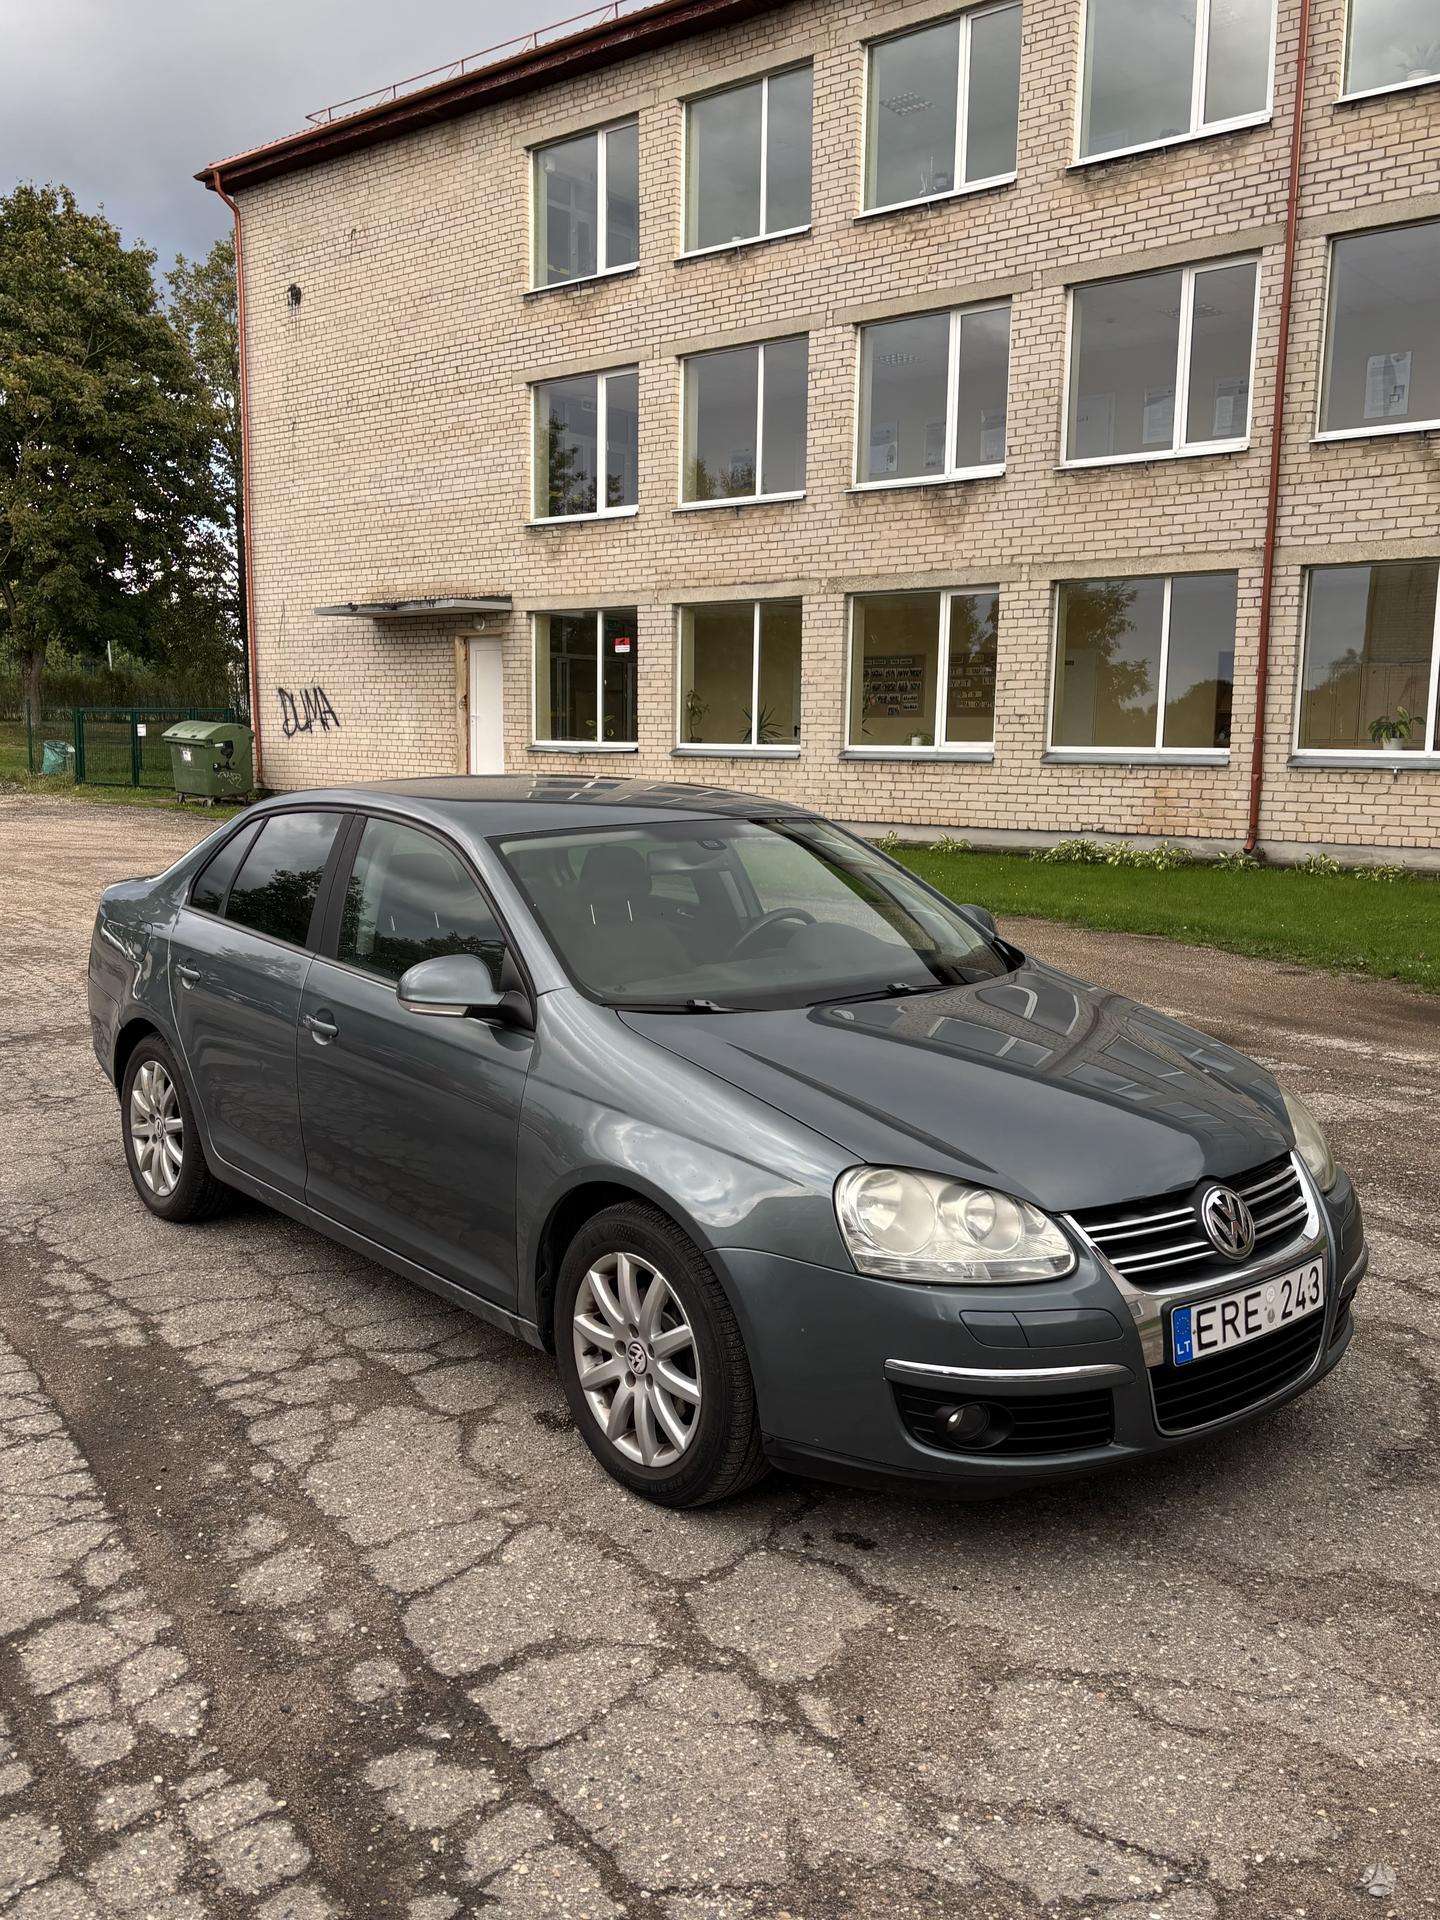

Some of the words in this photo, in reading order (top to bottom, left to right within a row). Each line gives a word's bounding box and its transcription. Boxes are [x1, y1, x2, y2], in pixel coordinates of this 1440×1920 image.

[1205, 1188, 1253, 1256] VW
[1196, 1291, 1262, 1351] ERE
[1281, 1266, 1320, 1320] 243
[1176, 1340, 1191, 1355] LT
